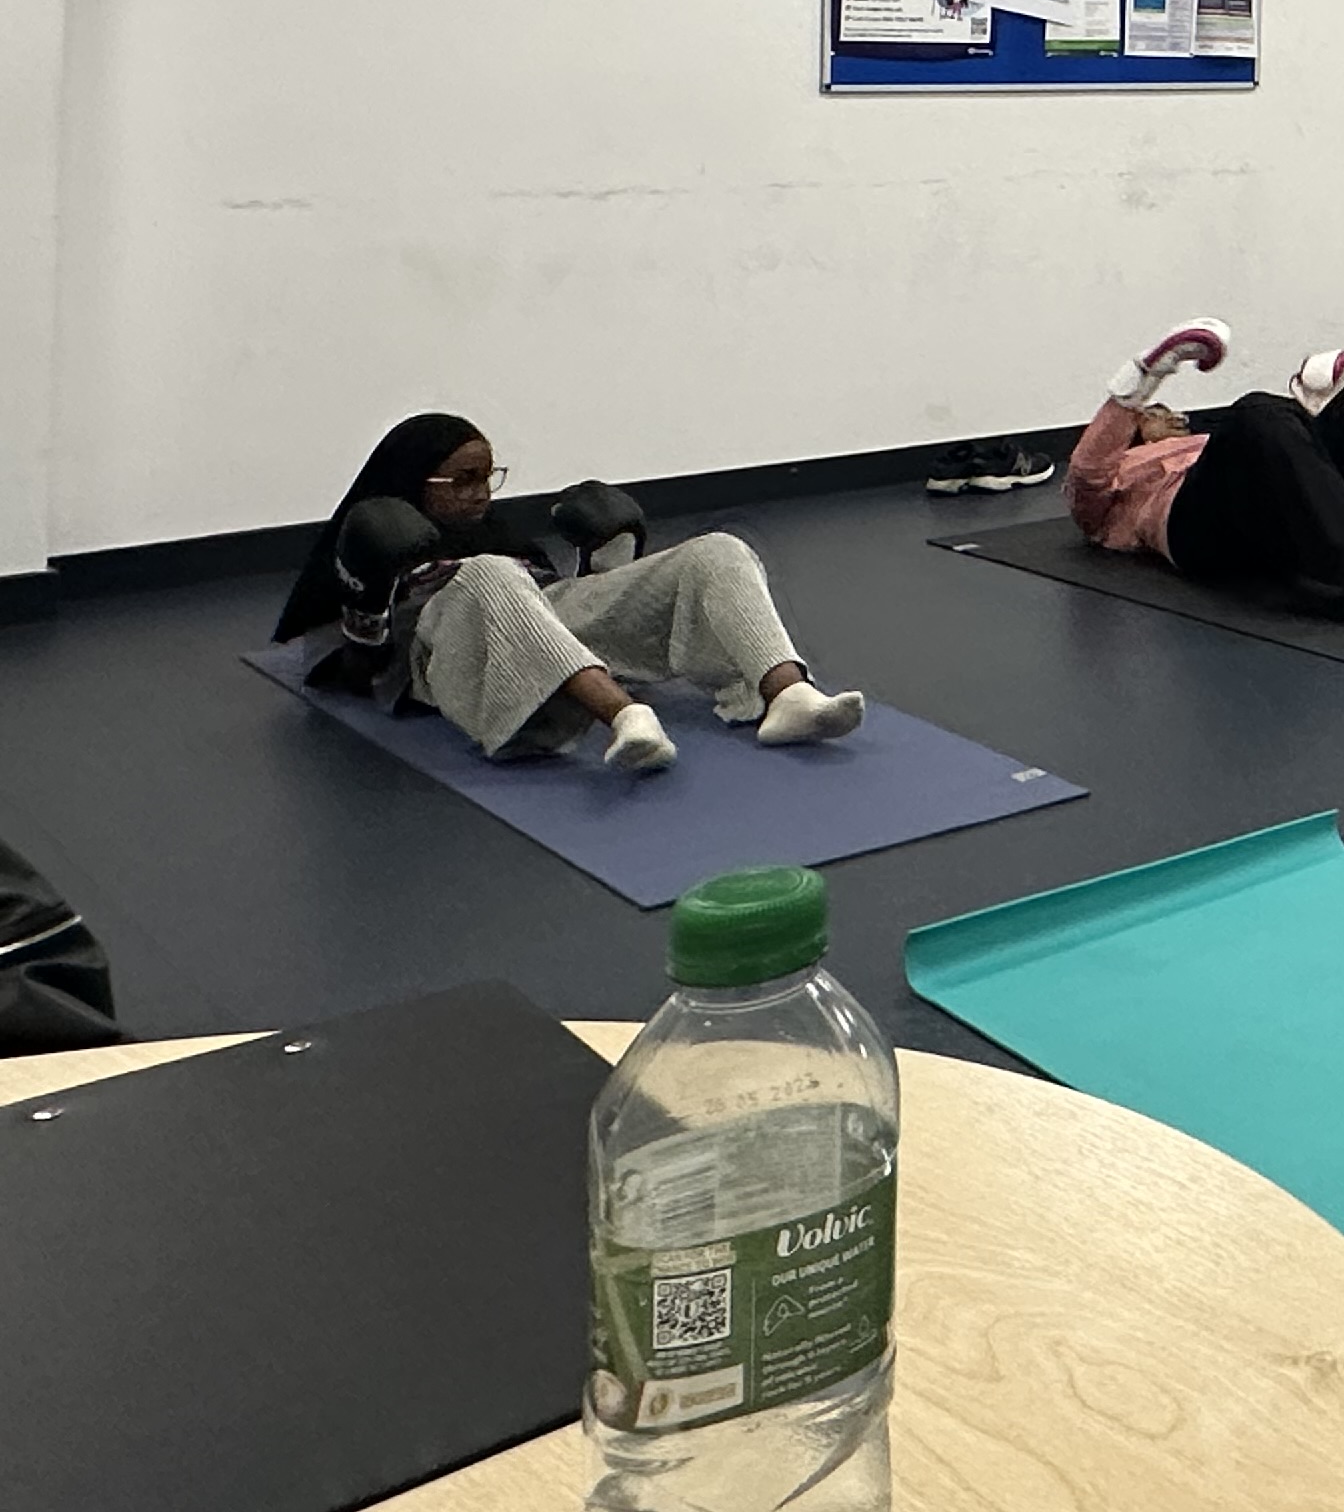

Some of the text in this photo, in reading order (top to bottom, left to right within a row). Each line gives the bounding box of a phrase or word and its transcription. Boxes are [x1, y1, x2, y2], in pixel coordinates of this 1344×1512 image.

[776, 1205, 872, 1258] Volvic
[772, 1235, 876, 1287] OUR UNIQUE WATER
